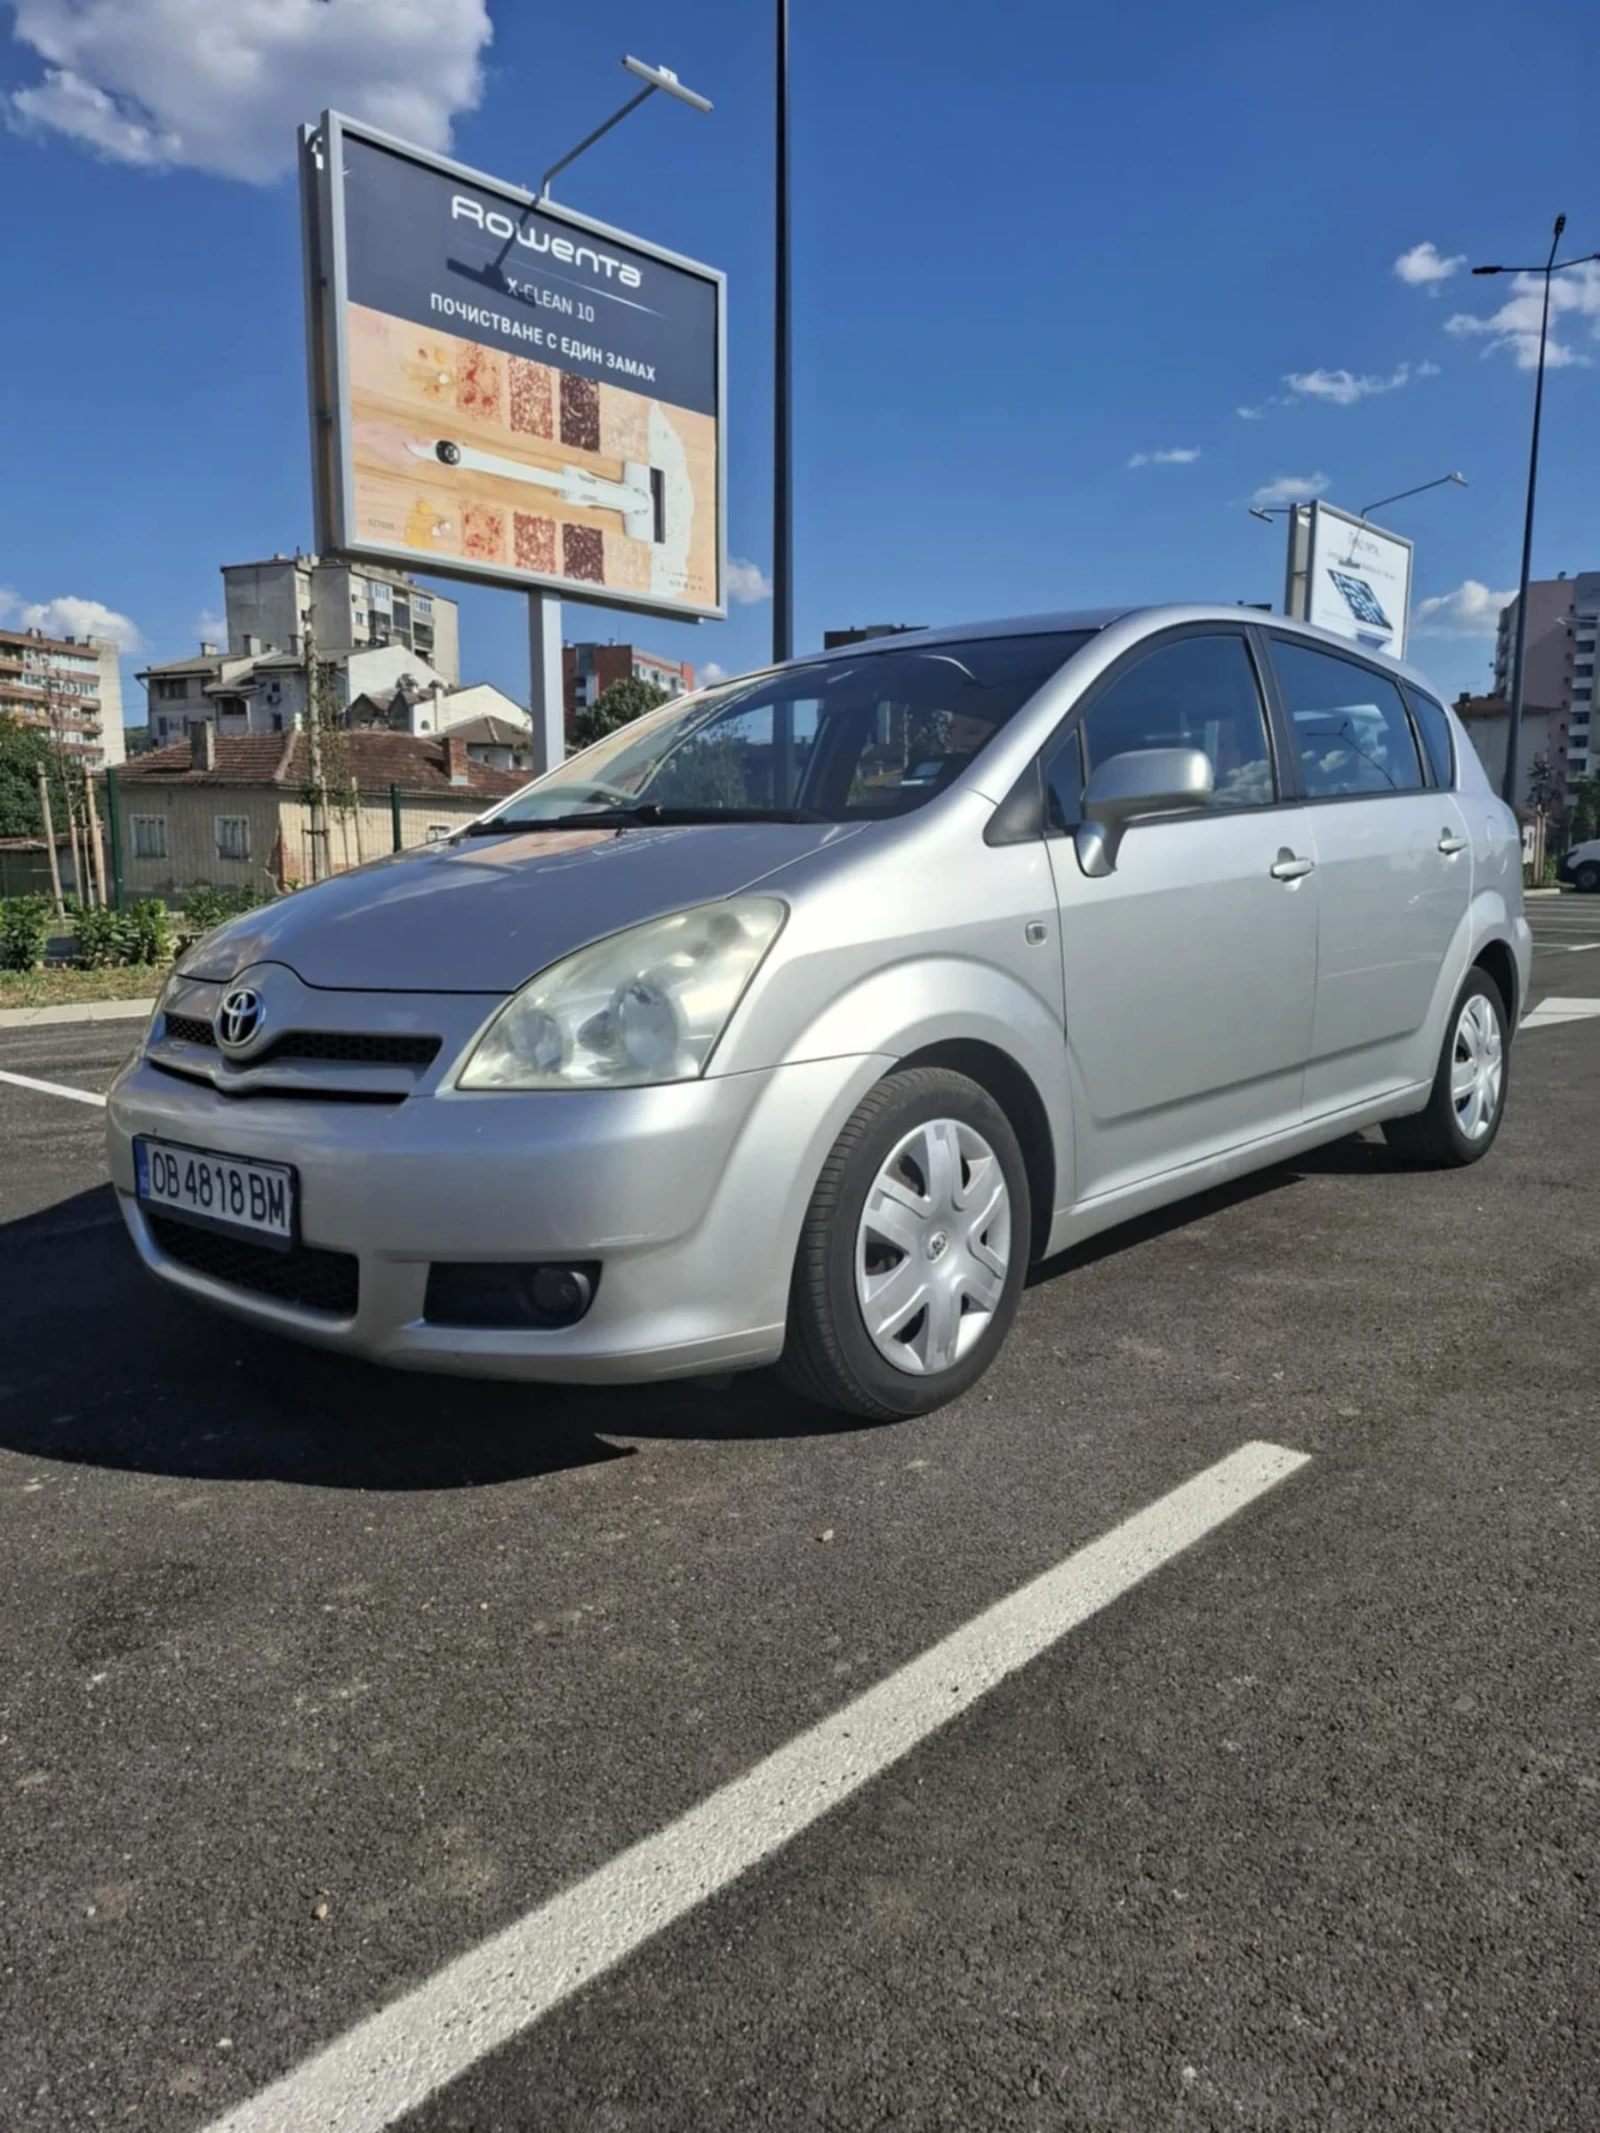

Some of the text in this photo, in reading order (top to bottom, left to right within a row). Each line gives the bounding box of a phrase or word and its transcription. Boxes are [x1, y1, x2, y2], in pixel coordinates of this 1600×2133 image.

[507, 277, 595, 322] X-CLEAN 10
[430, 293, 656, 382] ПОЧИСТВАНЕ С ЕДИН ЗАМАХ
